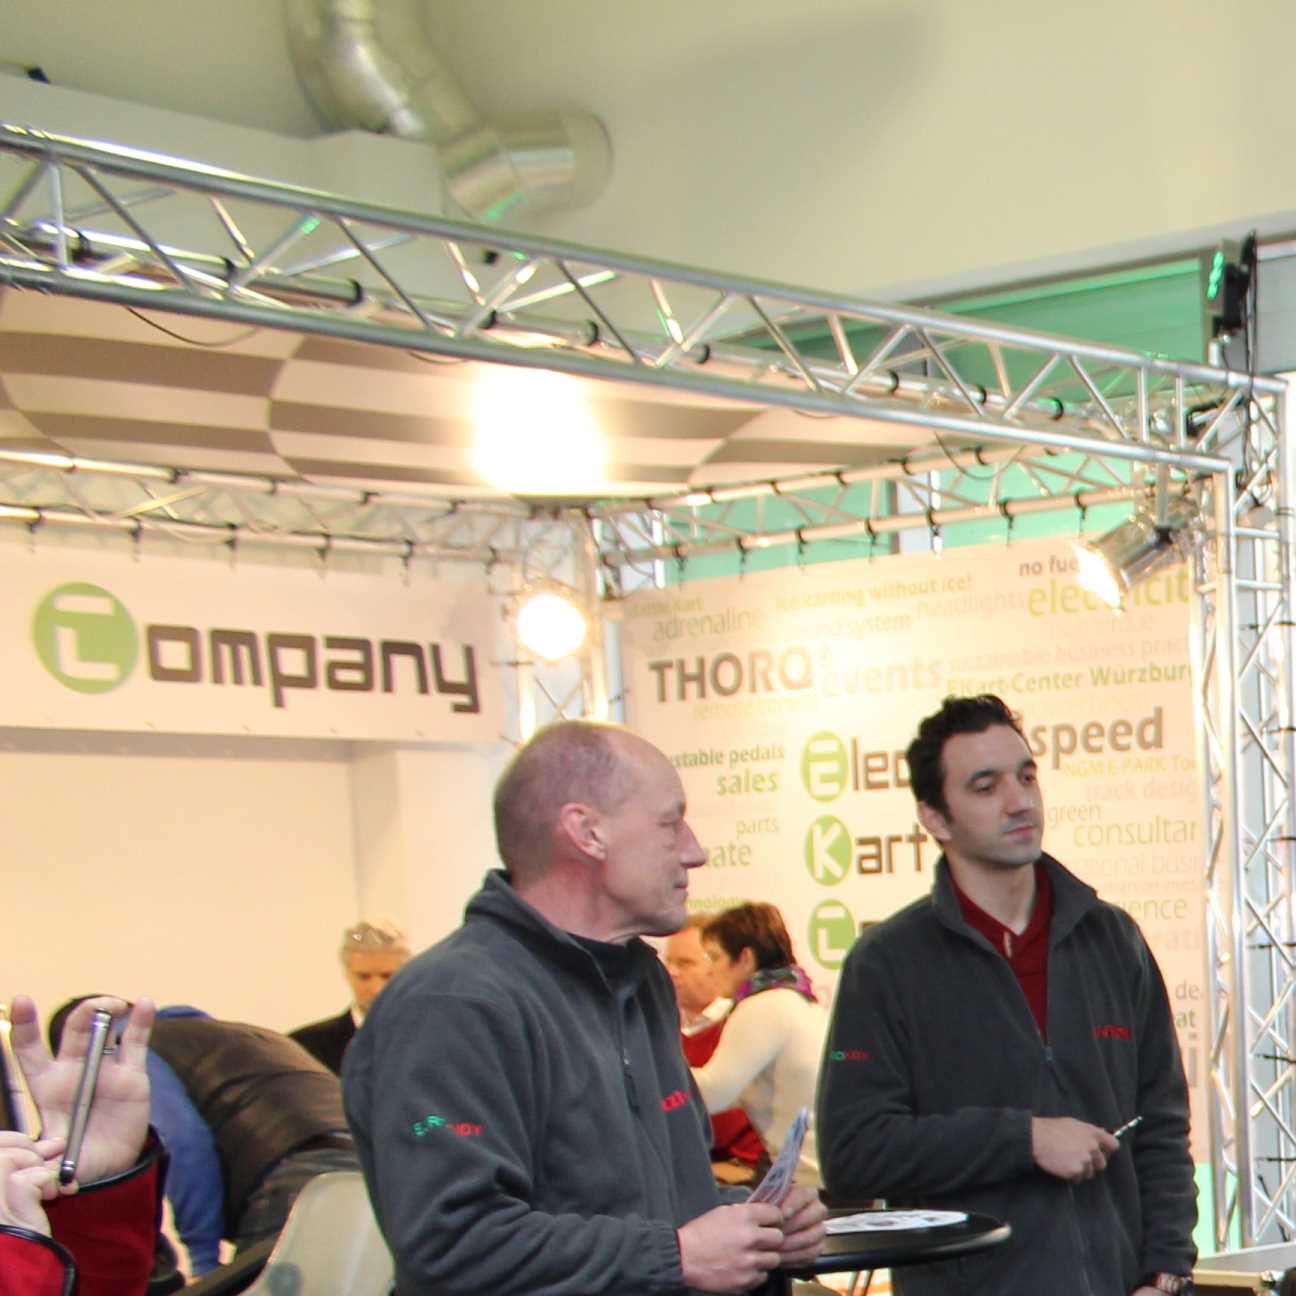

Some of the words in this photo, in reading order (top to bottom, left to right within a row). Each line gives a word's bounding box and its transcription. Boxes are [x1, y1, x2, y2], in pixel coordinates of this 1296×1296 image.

[1019, 561, 1043, 577] no
[1049, 554, 1079, 574] fue
[821, 656, 944, 698] events
[1031, 706, 1163, 770] speed
[729, 743, 785, 769] pedals
[716, 768, 780, 796] sales
[1143, 776, 1196, 804] desig
[736, 817, 780, 841] parts
[1047, 803, 1102, 828] green
[805, 816, 928, 886] Kart
